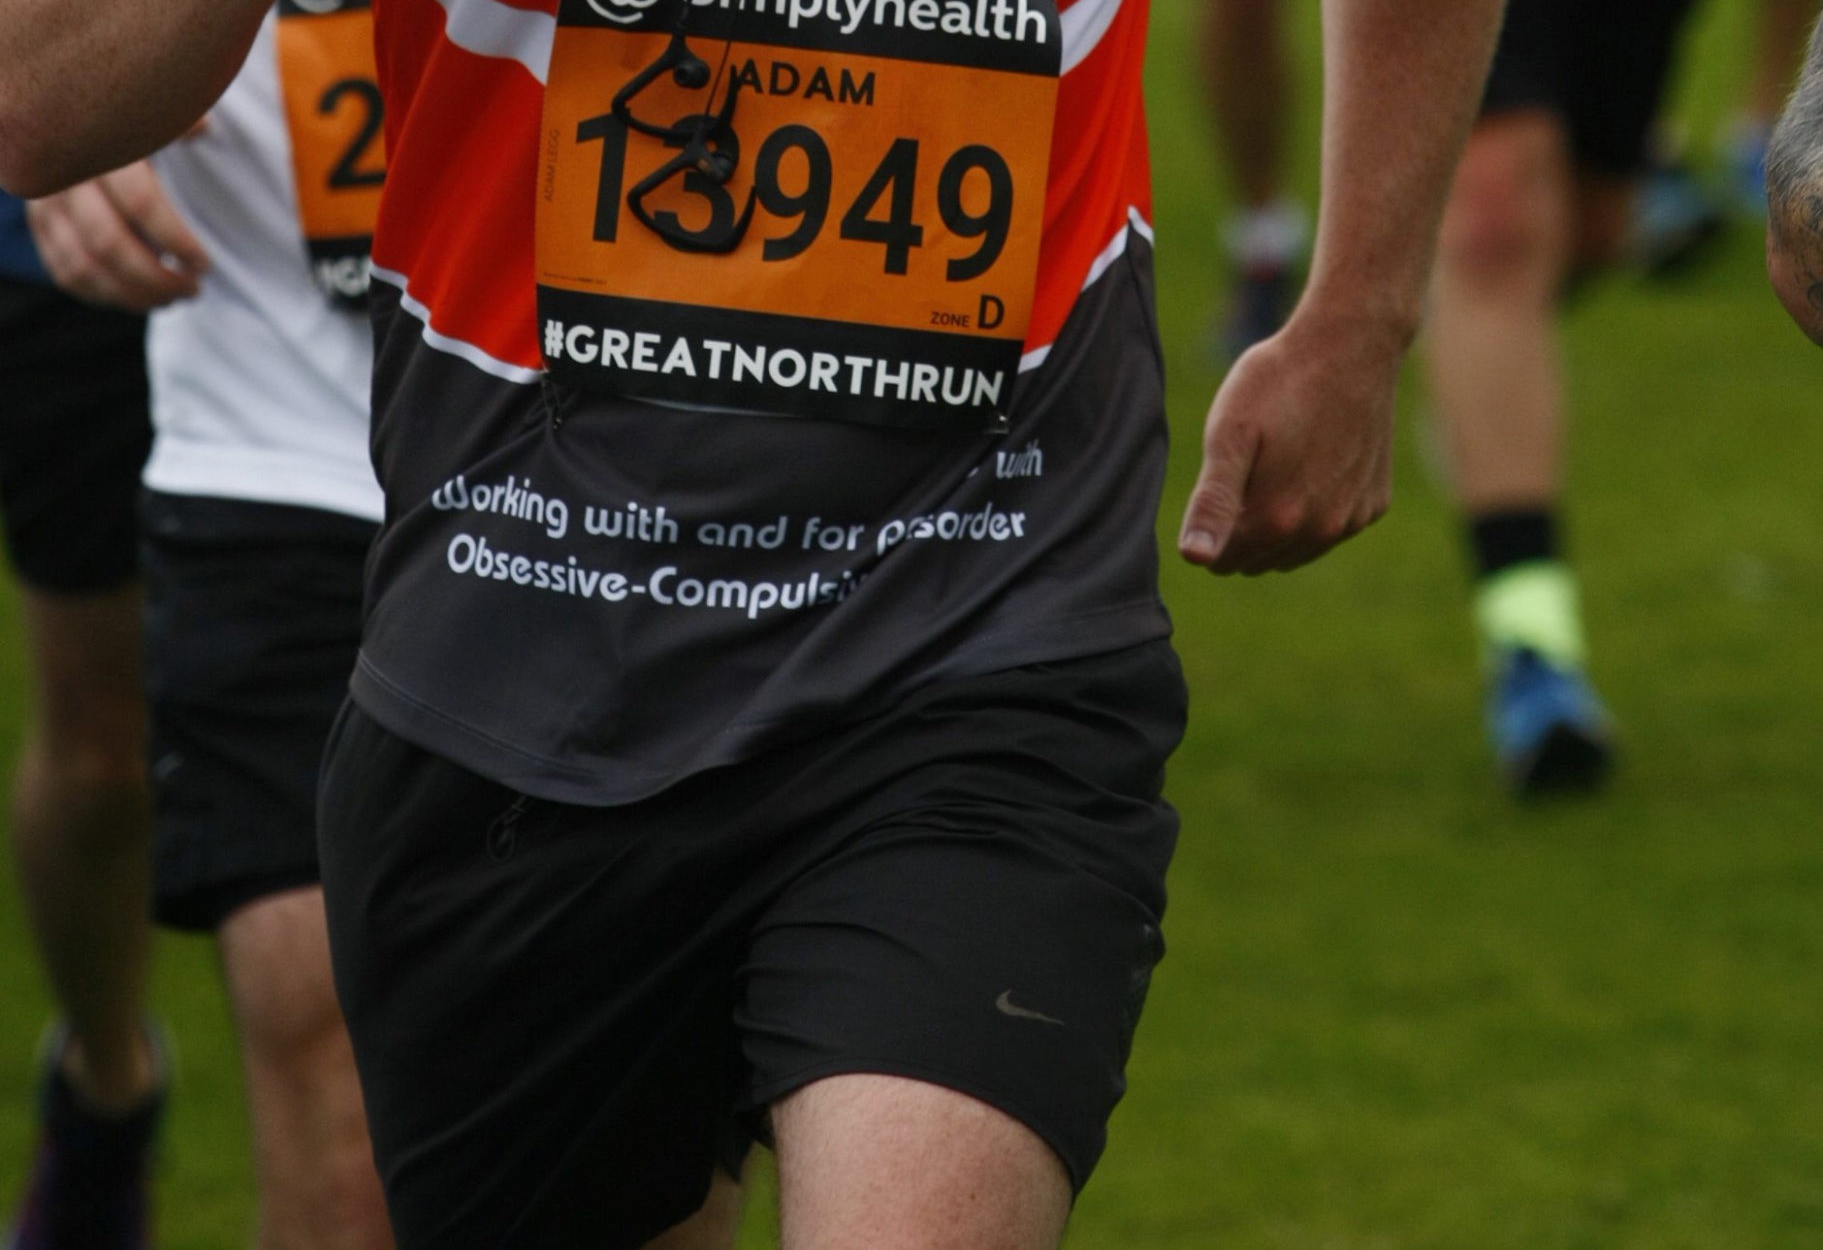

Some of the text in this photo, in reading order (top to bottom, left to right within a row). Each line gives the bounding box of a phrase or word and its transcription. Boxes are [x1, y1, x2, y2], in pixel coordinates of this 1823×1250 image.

[736, 58, 876, 106] ADAM
[575, 107, 1014, 283] 13949
[930, 294, 1006, 331] ZONE D
[544, 318, 1005, 408] #GREATNORTHRUN
[431, 474, 569, 539] Working
[584, 501, 679, 544] with
[697, 516, 788, 550] and
[802, 516, 865, 551] for
[447, 534, 868, 619] Obsessive-Compulsi
